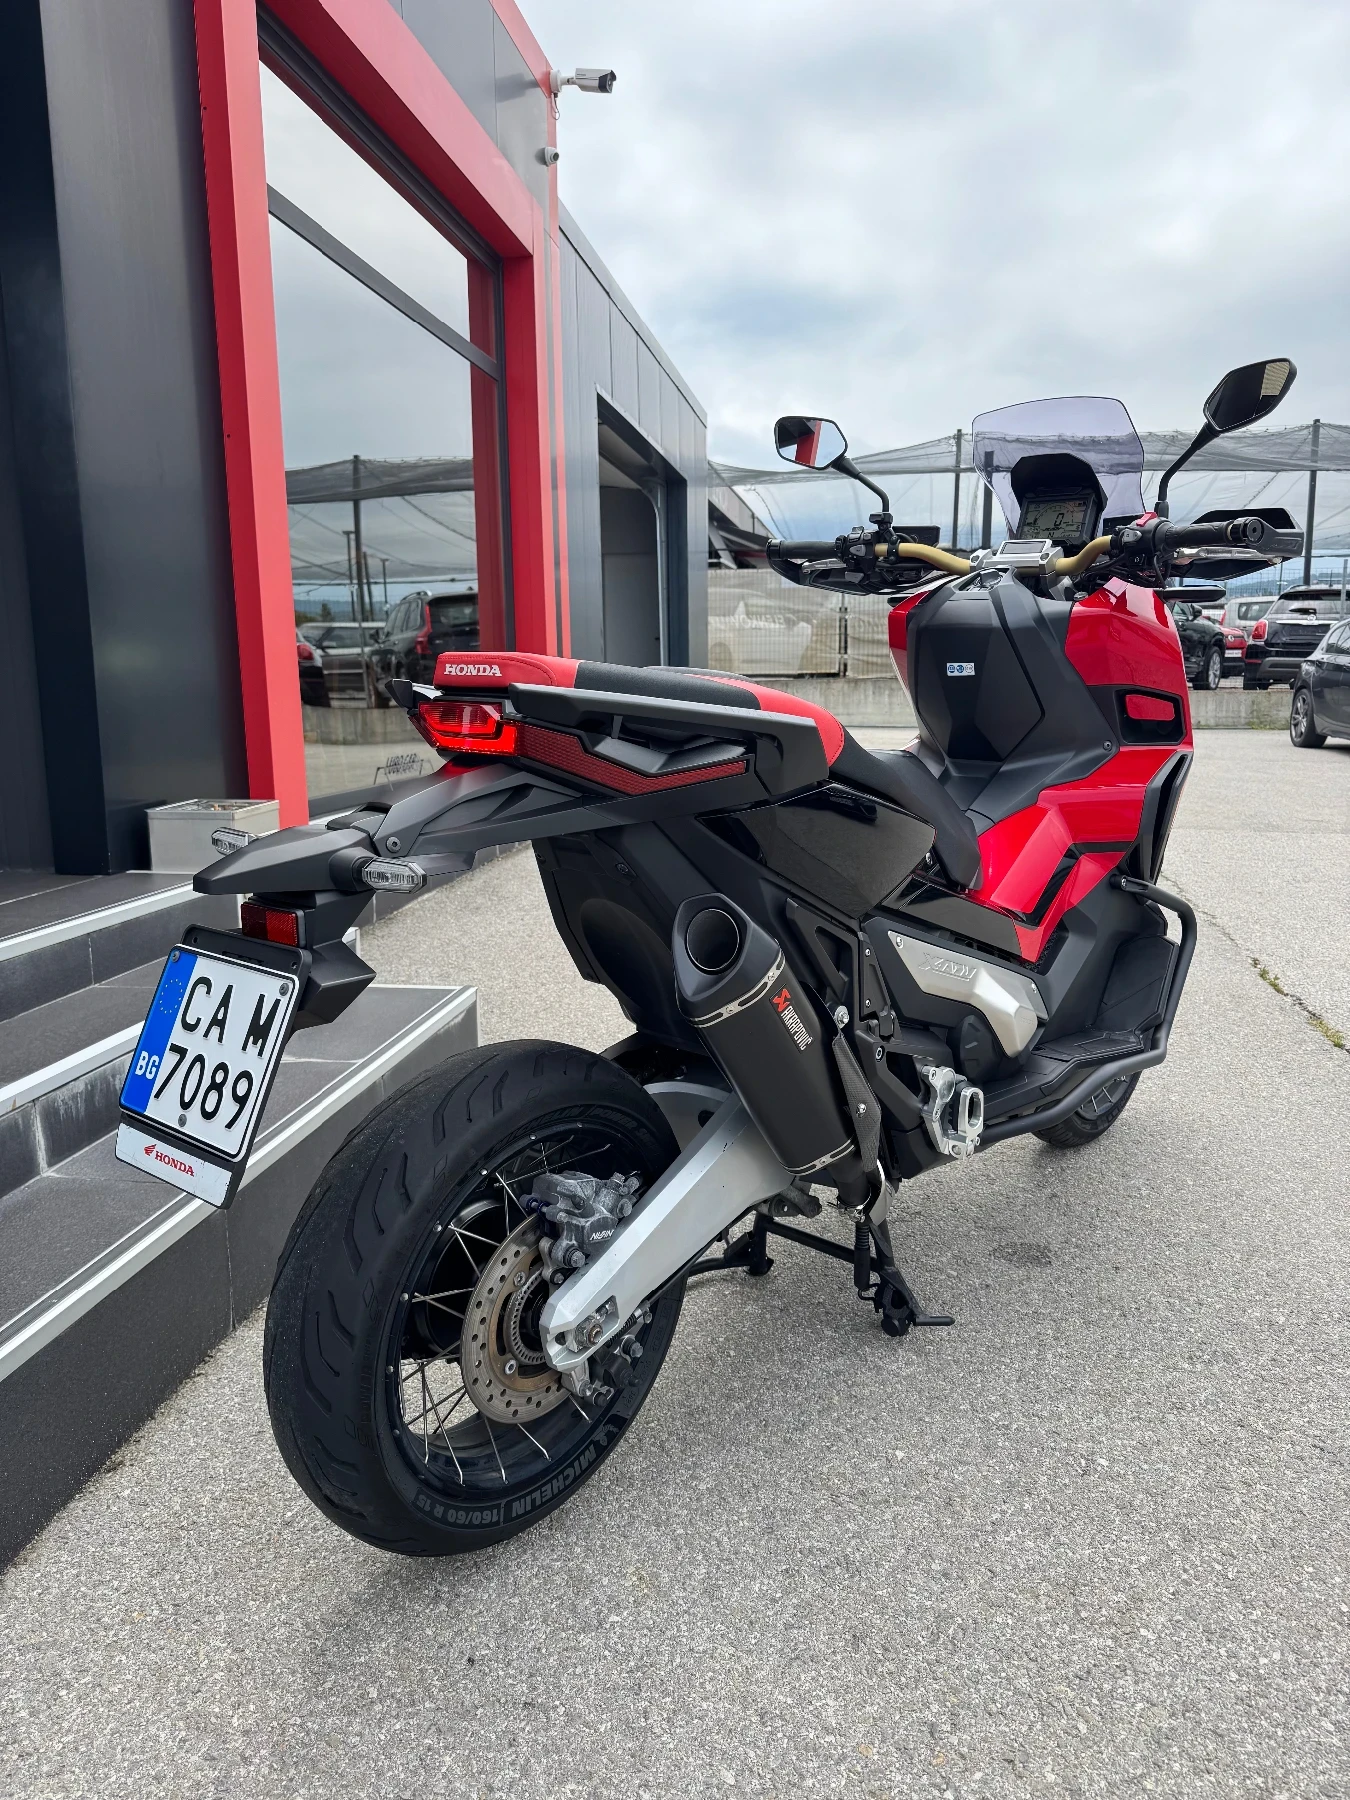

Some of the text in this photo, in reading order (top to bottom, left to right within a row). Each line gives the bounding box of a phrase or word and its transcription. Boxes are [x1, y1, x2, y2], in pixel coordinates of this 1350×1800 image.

[443, 663, 503, 677] HONDA
[180, 976, 282, 1059] CA M
[134, 1050, 160, 1080] BG
[153, 1043, 254, 1130] 7089
[154, 1149, 195, 1177] HONDA
[512, 1445, 597, 1518] MICHELIN
[416, 1495, 498, 1525] 160/60 R 15
